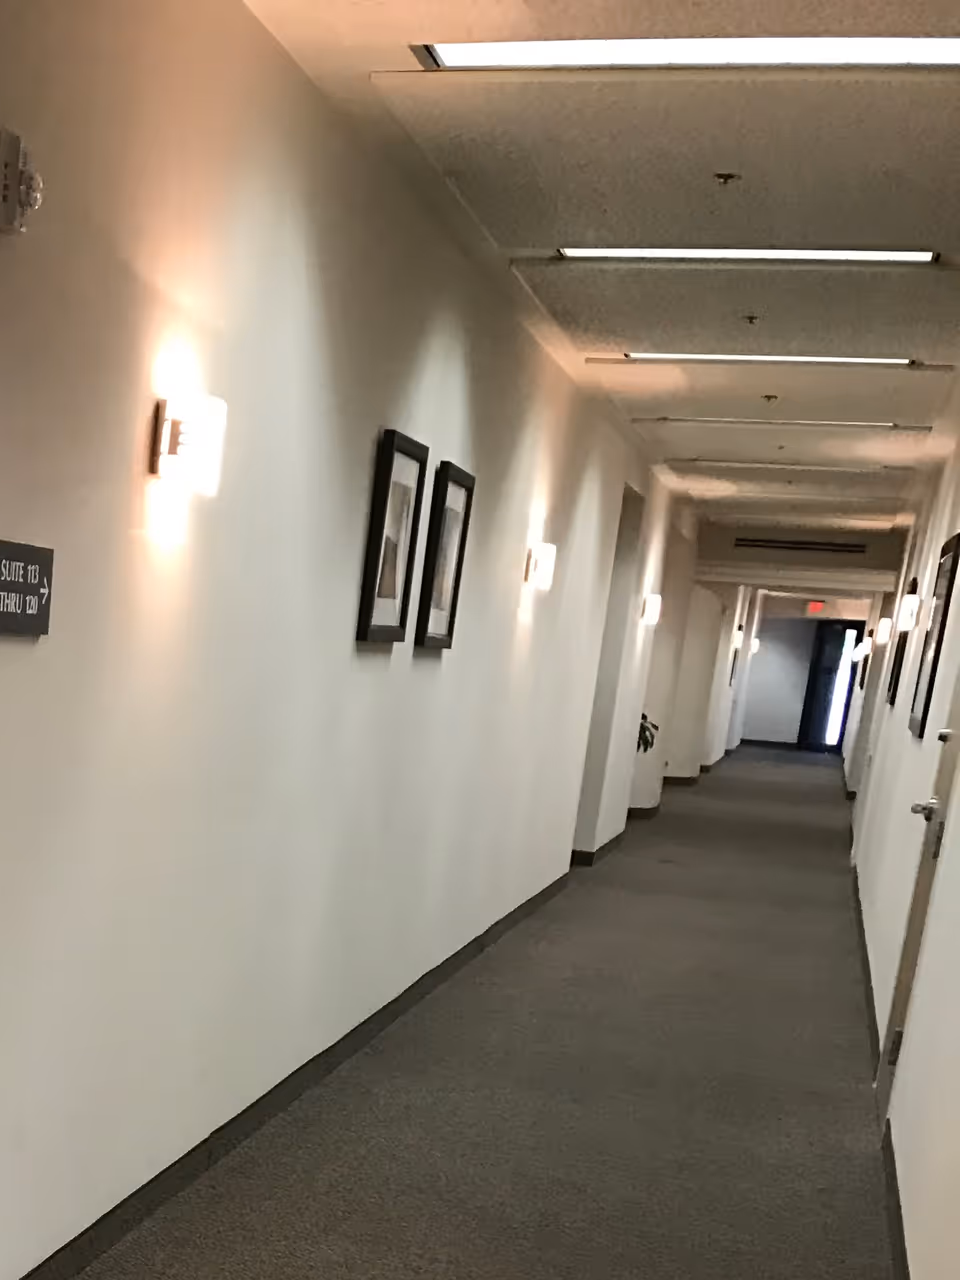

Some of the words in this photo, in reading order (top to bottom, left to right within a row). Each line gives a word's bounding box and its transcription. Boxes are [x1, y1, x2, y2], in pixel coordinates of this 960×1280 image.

[1, 559, 24, 582] SUITE
[27, 564, 40, 584] 113
[0, 591, 23, 613] THRU
[26, 595, 38, 614] 120
